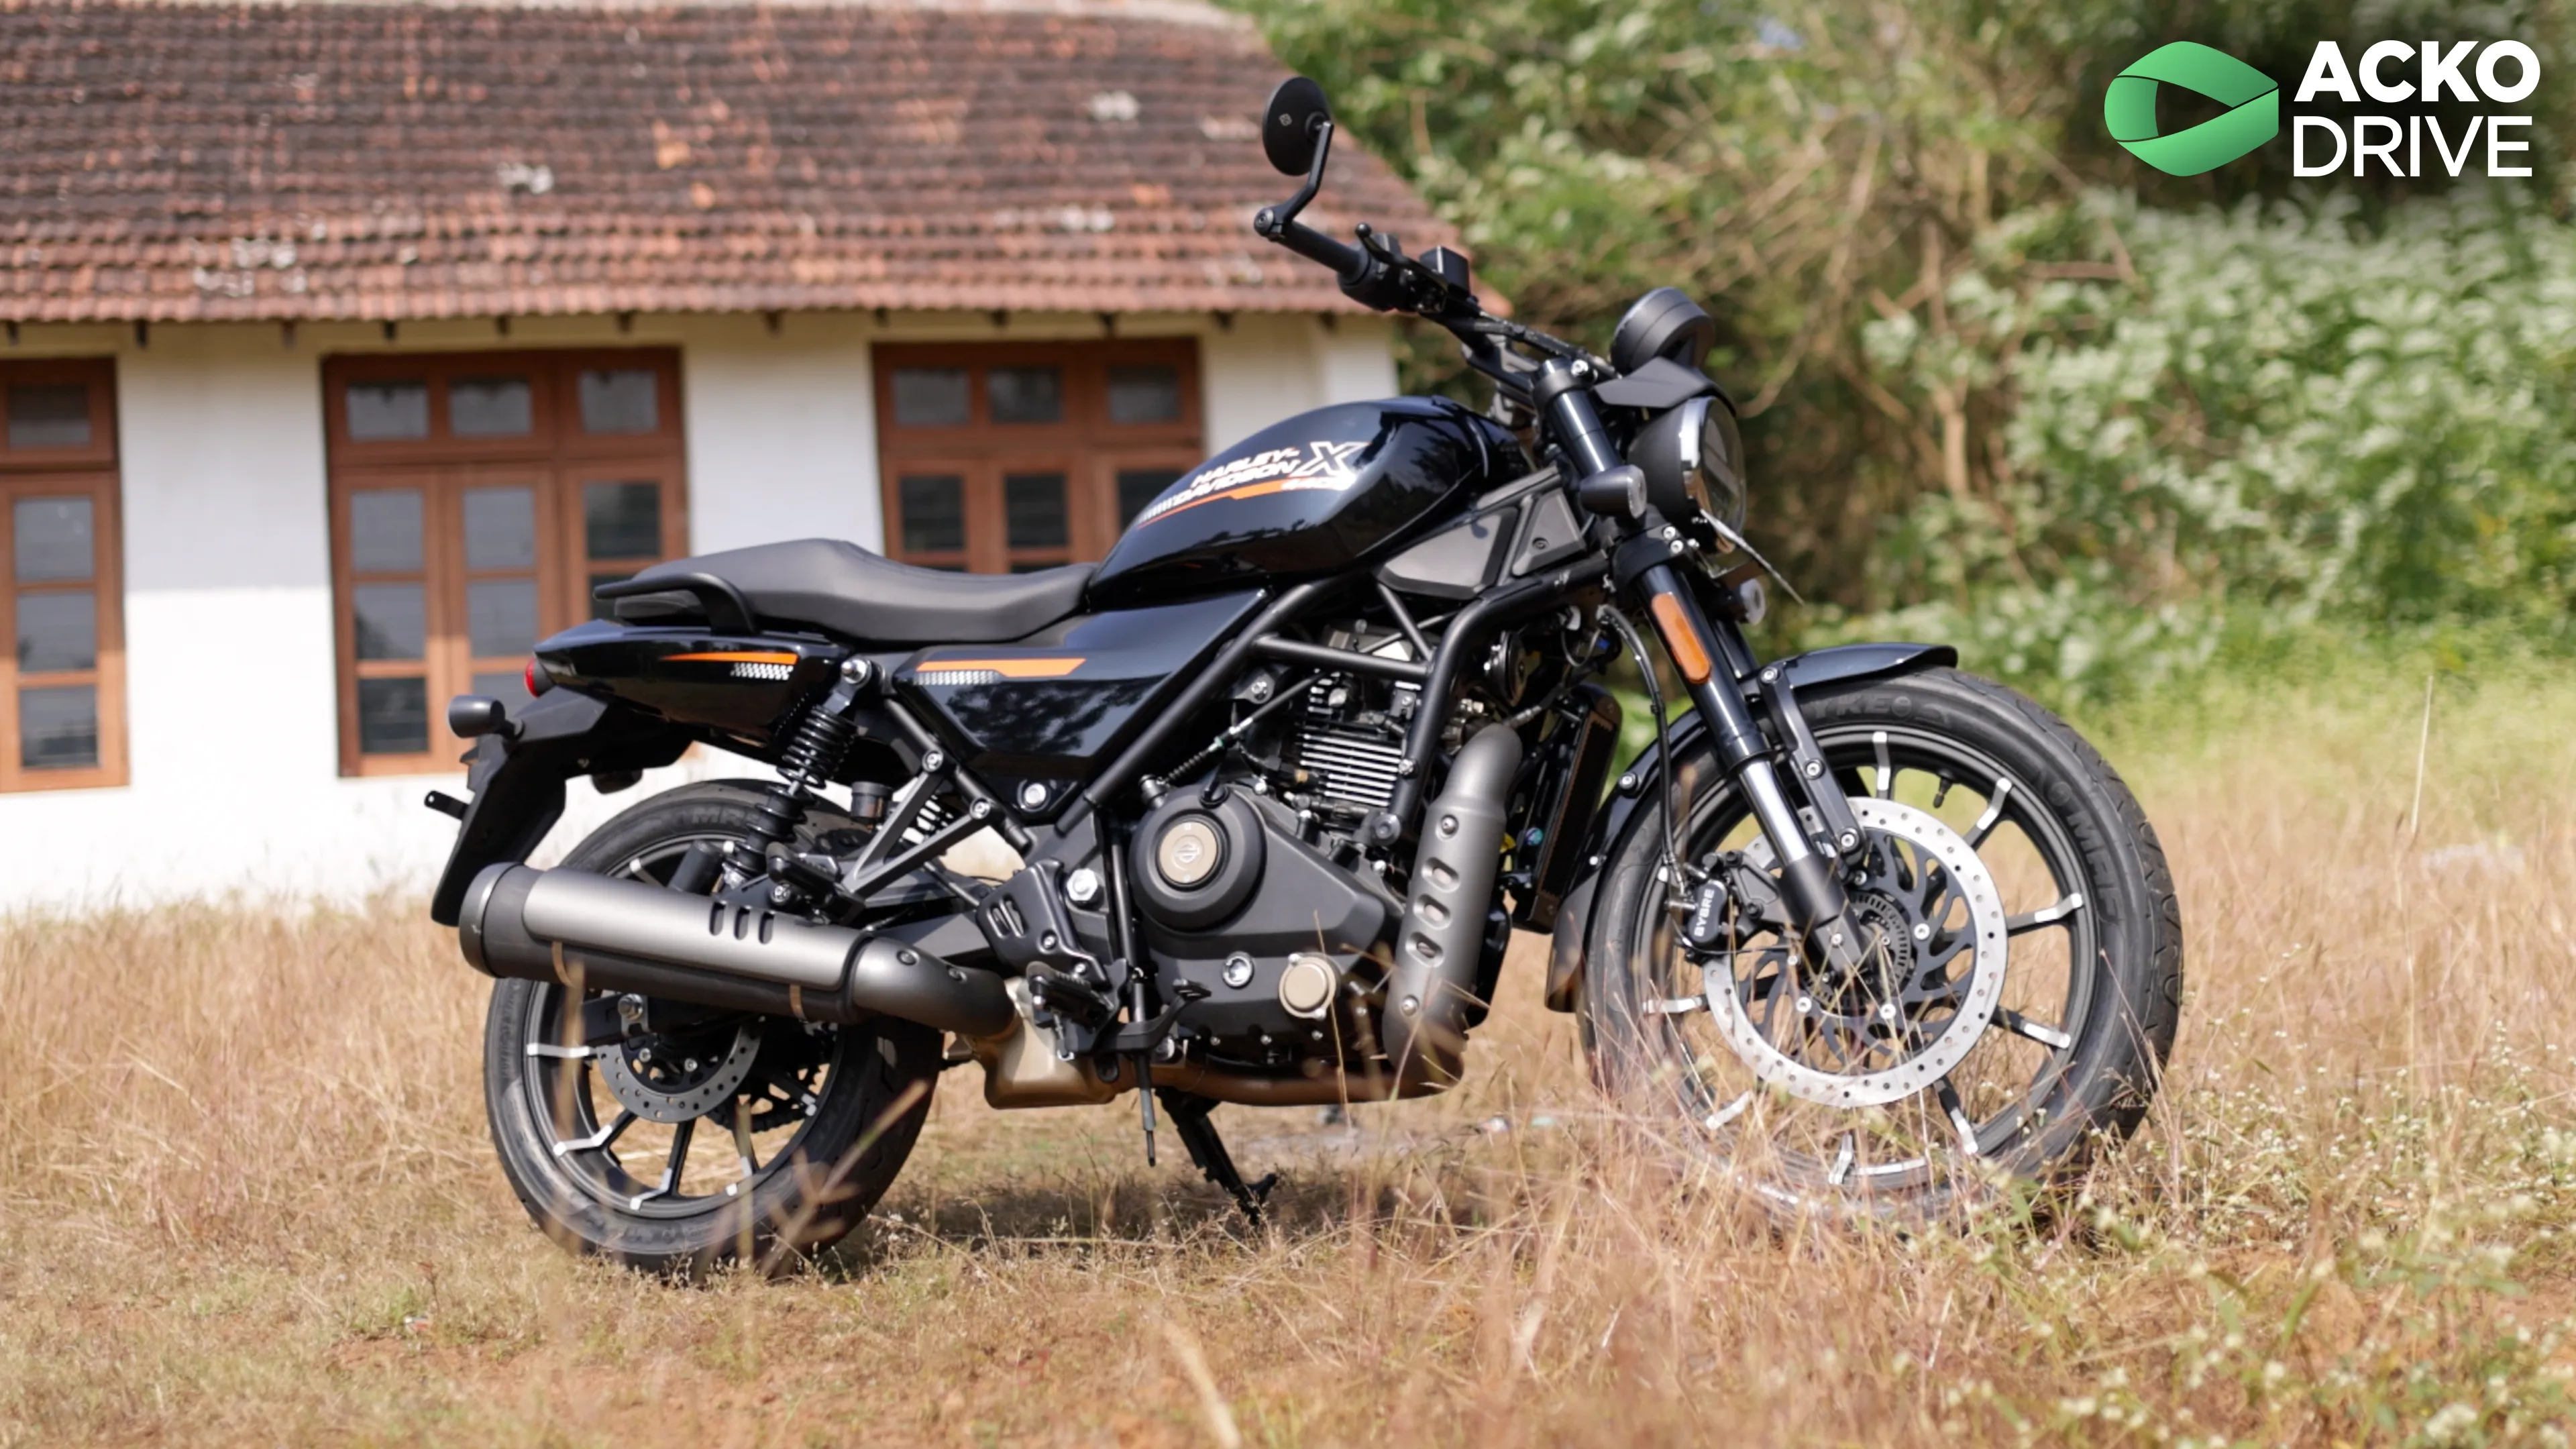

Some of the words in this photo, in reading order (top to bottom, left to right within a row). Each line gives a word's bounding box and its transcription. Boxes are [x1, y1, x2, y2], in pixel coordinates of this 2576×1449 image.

[1288, 441, 1372, 477] X
[1172, 460, 1301, 506] DAVIDSON
[2066, 810, 2125, 920] MRF
[1694, 889, 1715, 937] BYBRE
